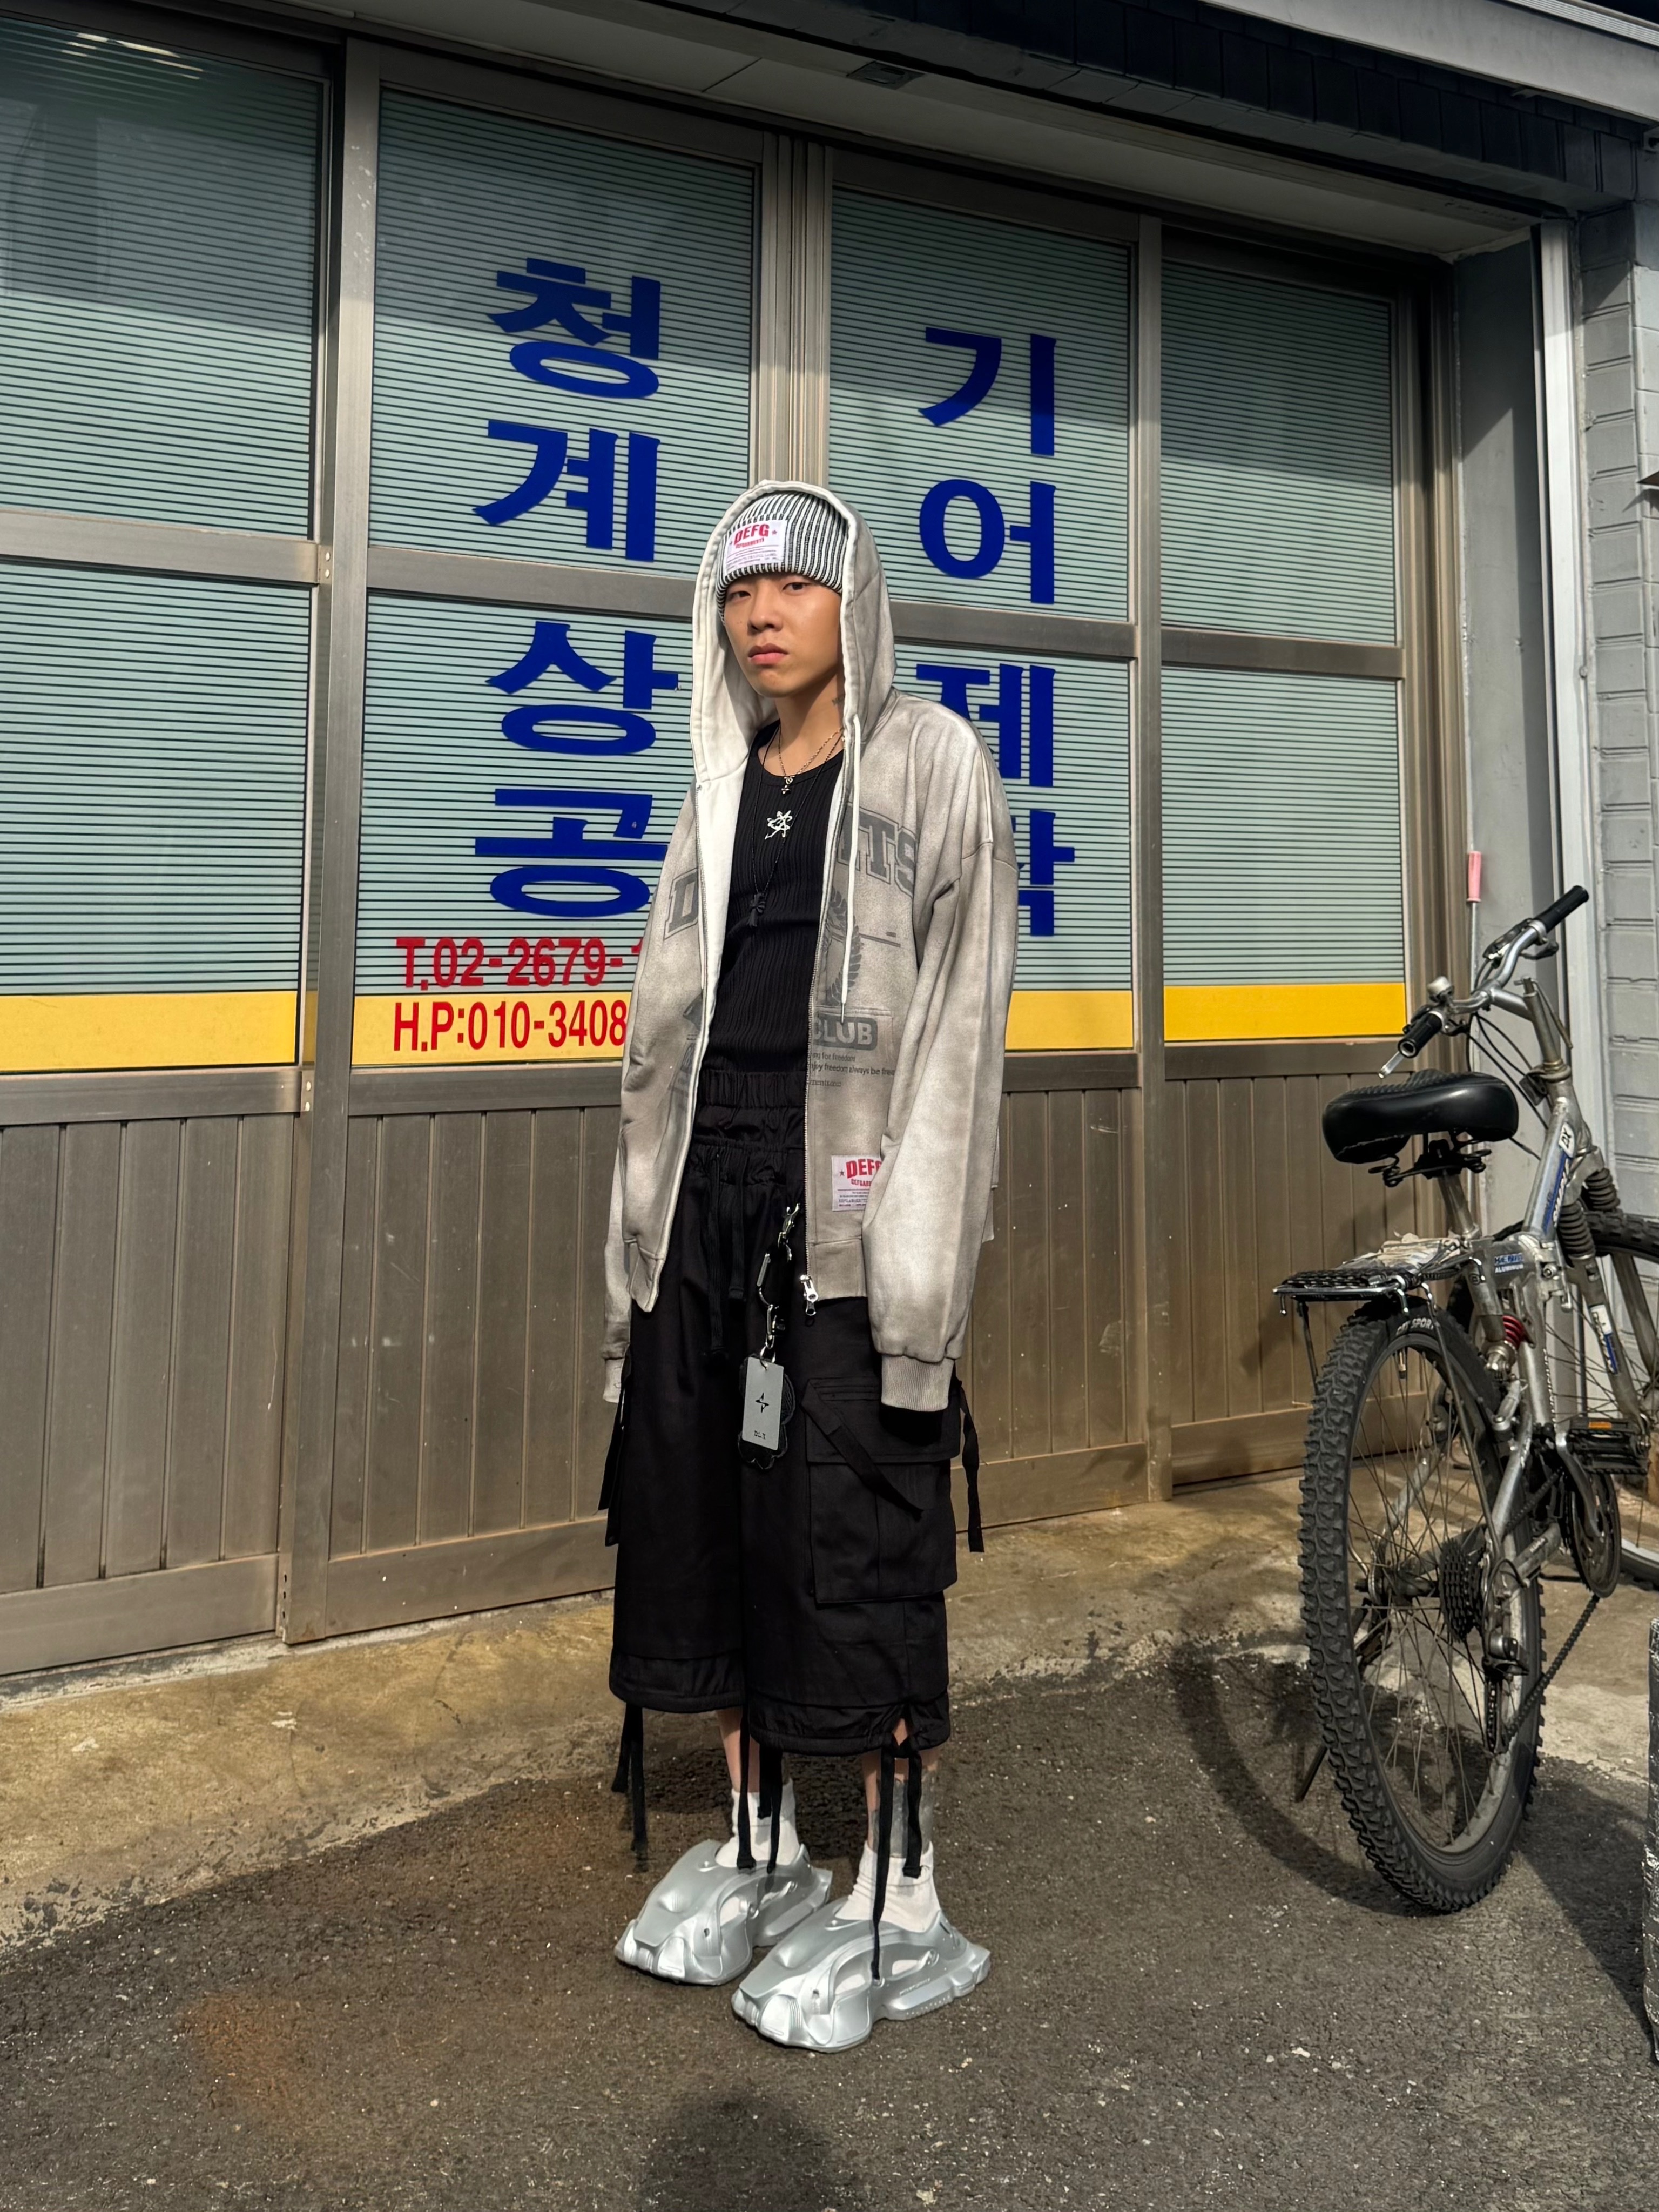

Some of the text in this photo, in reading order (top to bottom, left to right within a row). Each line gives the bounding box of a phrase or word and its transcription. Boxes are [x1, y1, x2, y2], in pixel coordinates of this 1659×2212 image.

[733, 523, 770, 546] DEFG
[396, 936, 643, 991] T.02-2679-
[821, 1052, 831, 1060] for
[832, 1054, 855, 1063] freedom
[824, 1064, 848, 1073] freedom
[871, 1067, 880, 1075] be
